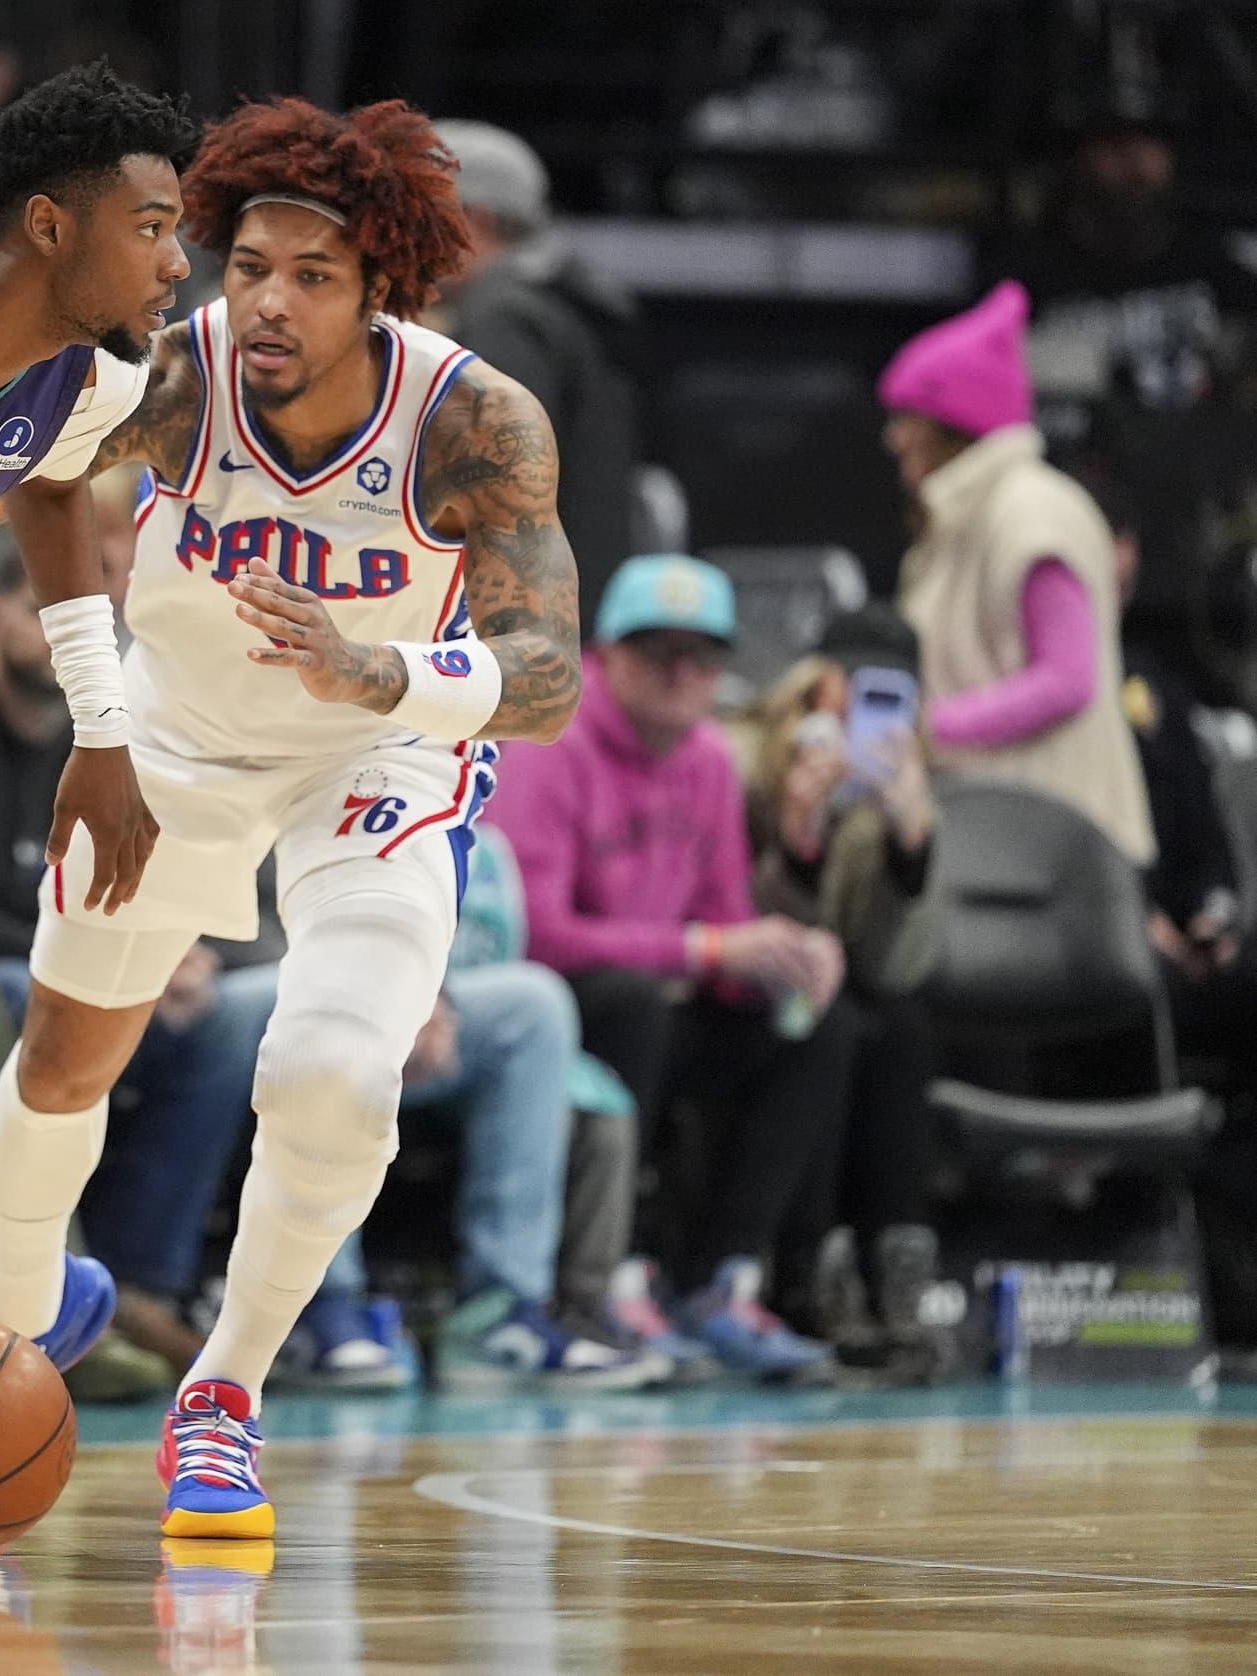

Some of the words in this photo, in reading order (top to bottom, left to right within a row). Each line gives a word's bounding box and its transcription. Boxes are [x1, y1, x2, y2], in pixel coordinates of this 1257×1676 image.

[338, 499, 402, 518] crypto.com
[176, 503, 412, 600] PHILA
[334, 793, 407, 838] 76
